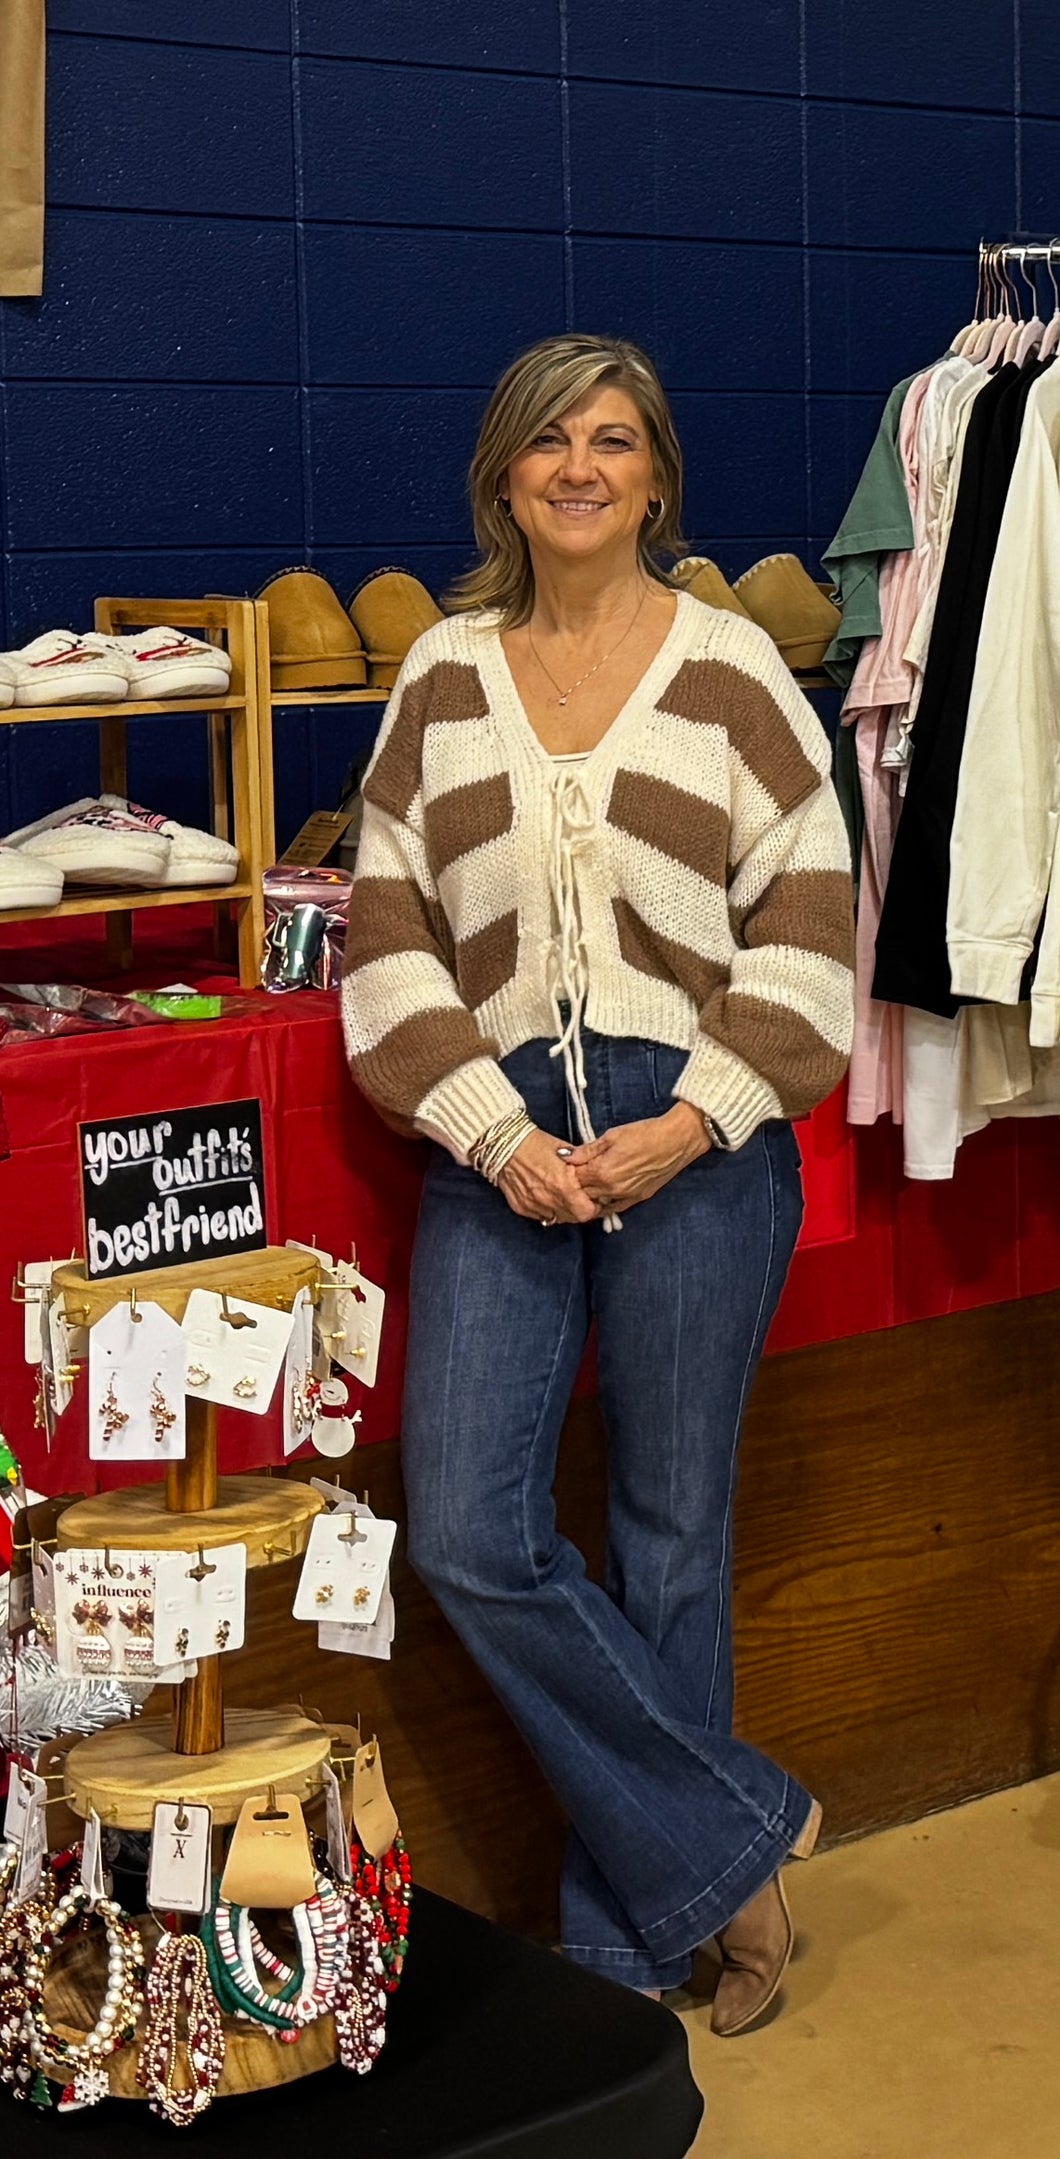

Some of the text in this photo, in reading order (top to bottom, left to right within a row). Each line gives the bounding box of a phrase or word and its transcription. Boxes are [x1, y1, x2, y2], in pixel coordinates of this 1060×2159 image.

[84, 1120, 172, 1185] your
[152, 1127, 253, 1190] outfit's
[82, 1583, 152, 1598] influence
